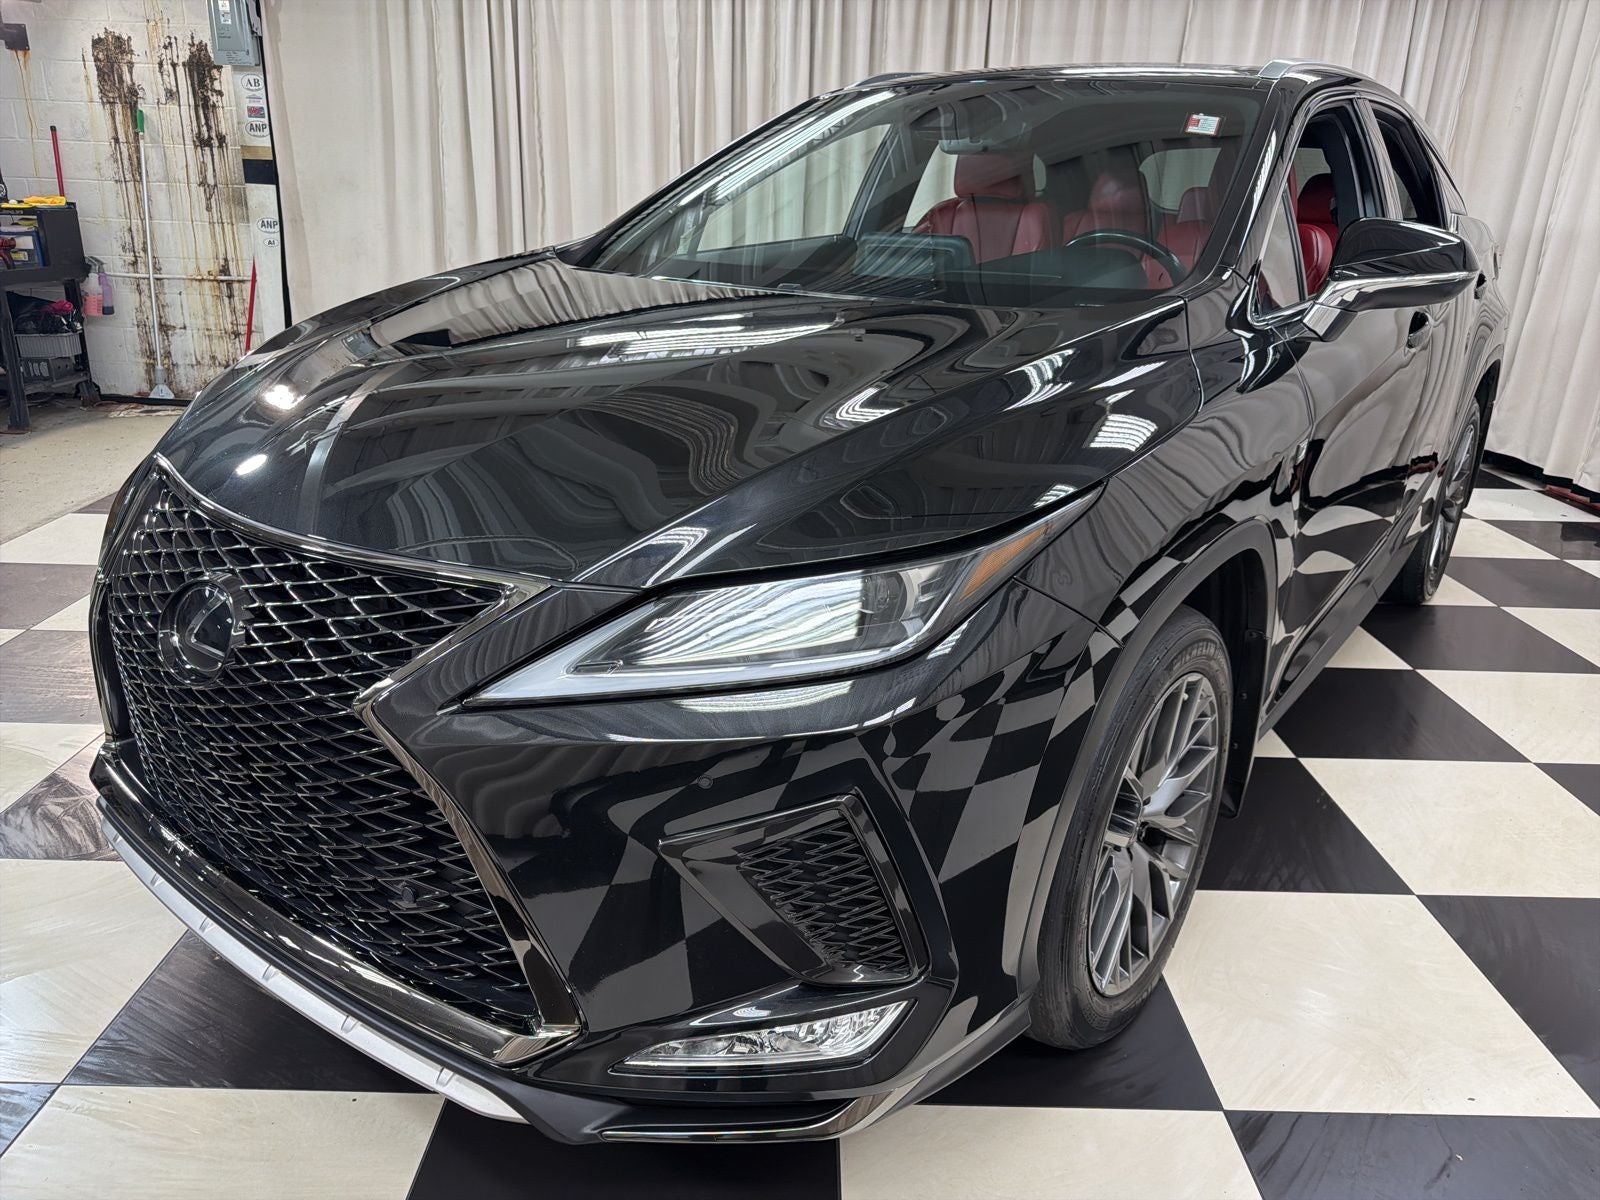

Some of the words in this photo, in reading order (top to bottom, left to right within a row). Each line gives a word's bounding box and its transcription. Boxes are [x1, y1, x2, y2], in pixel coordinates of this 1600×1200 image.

[246, 79, 261, 87] AB
[249, 123, 267, 133] ANP
[260, 220, 278, 229] ANP
